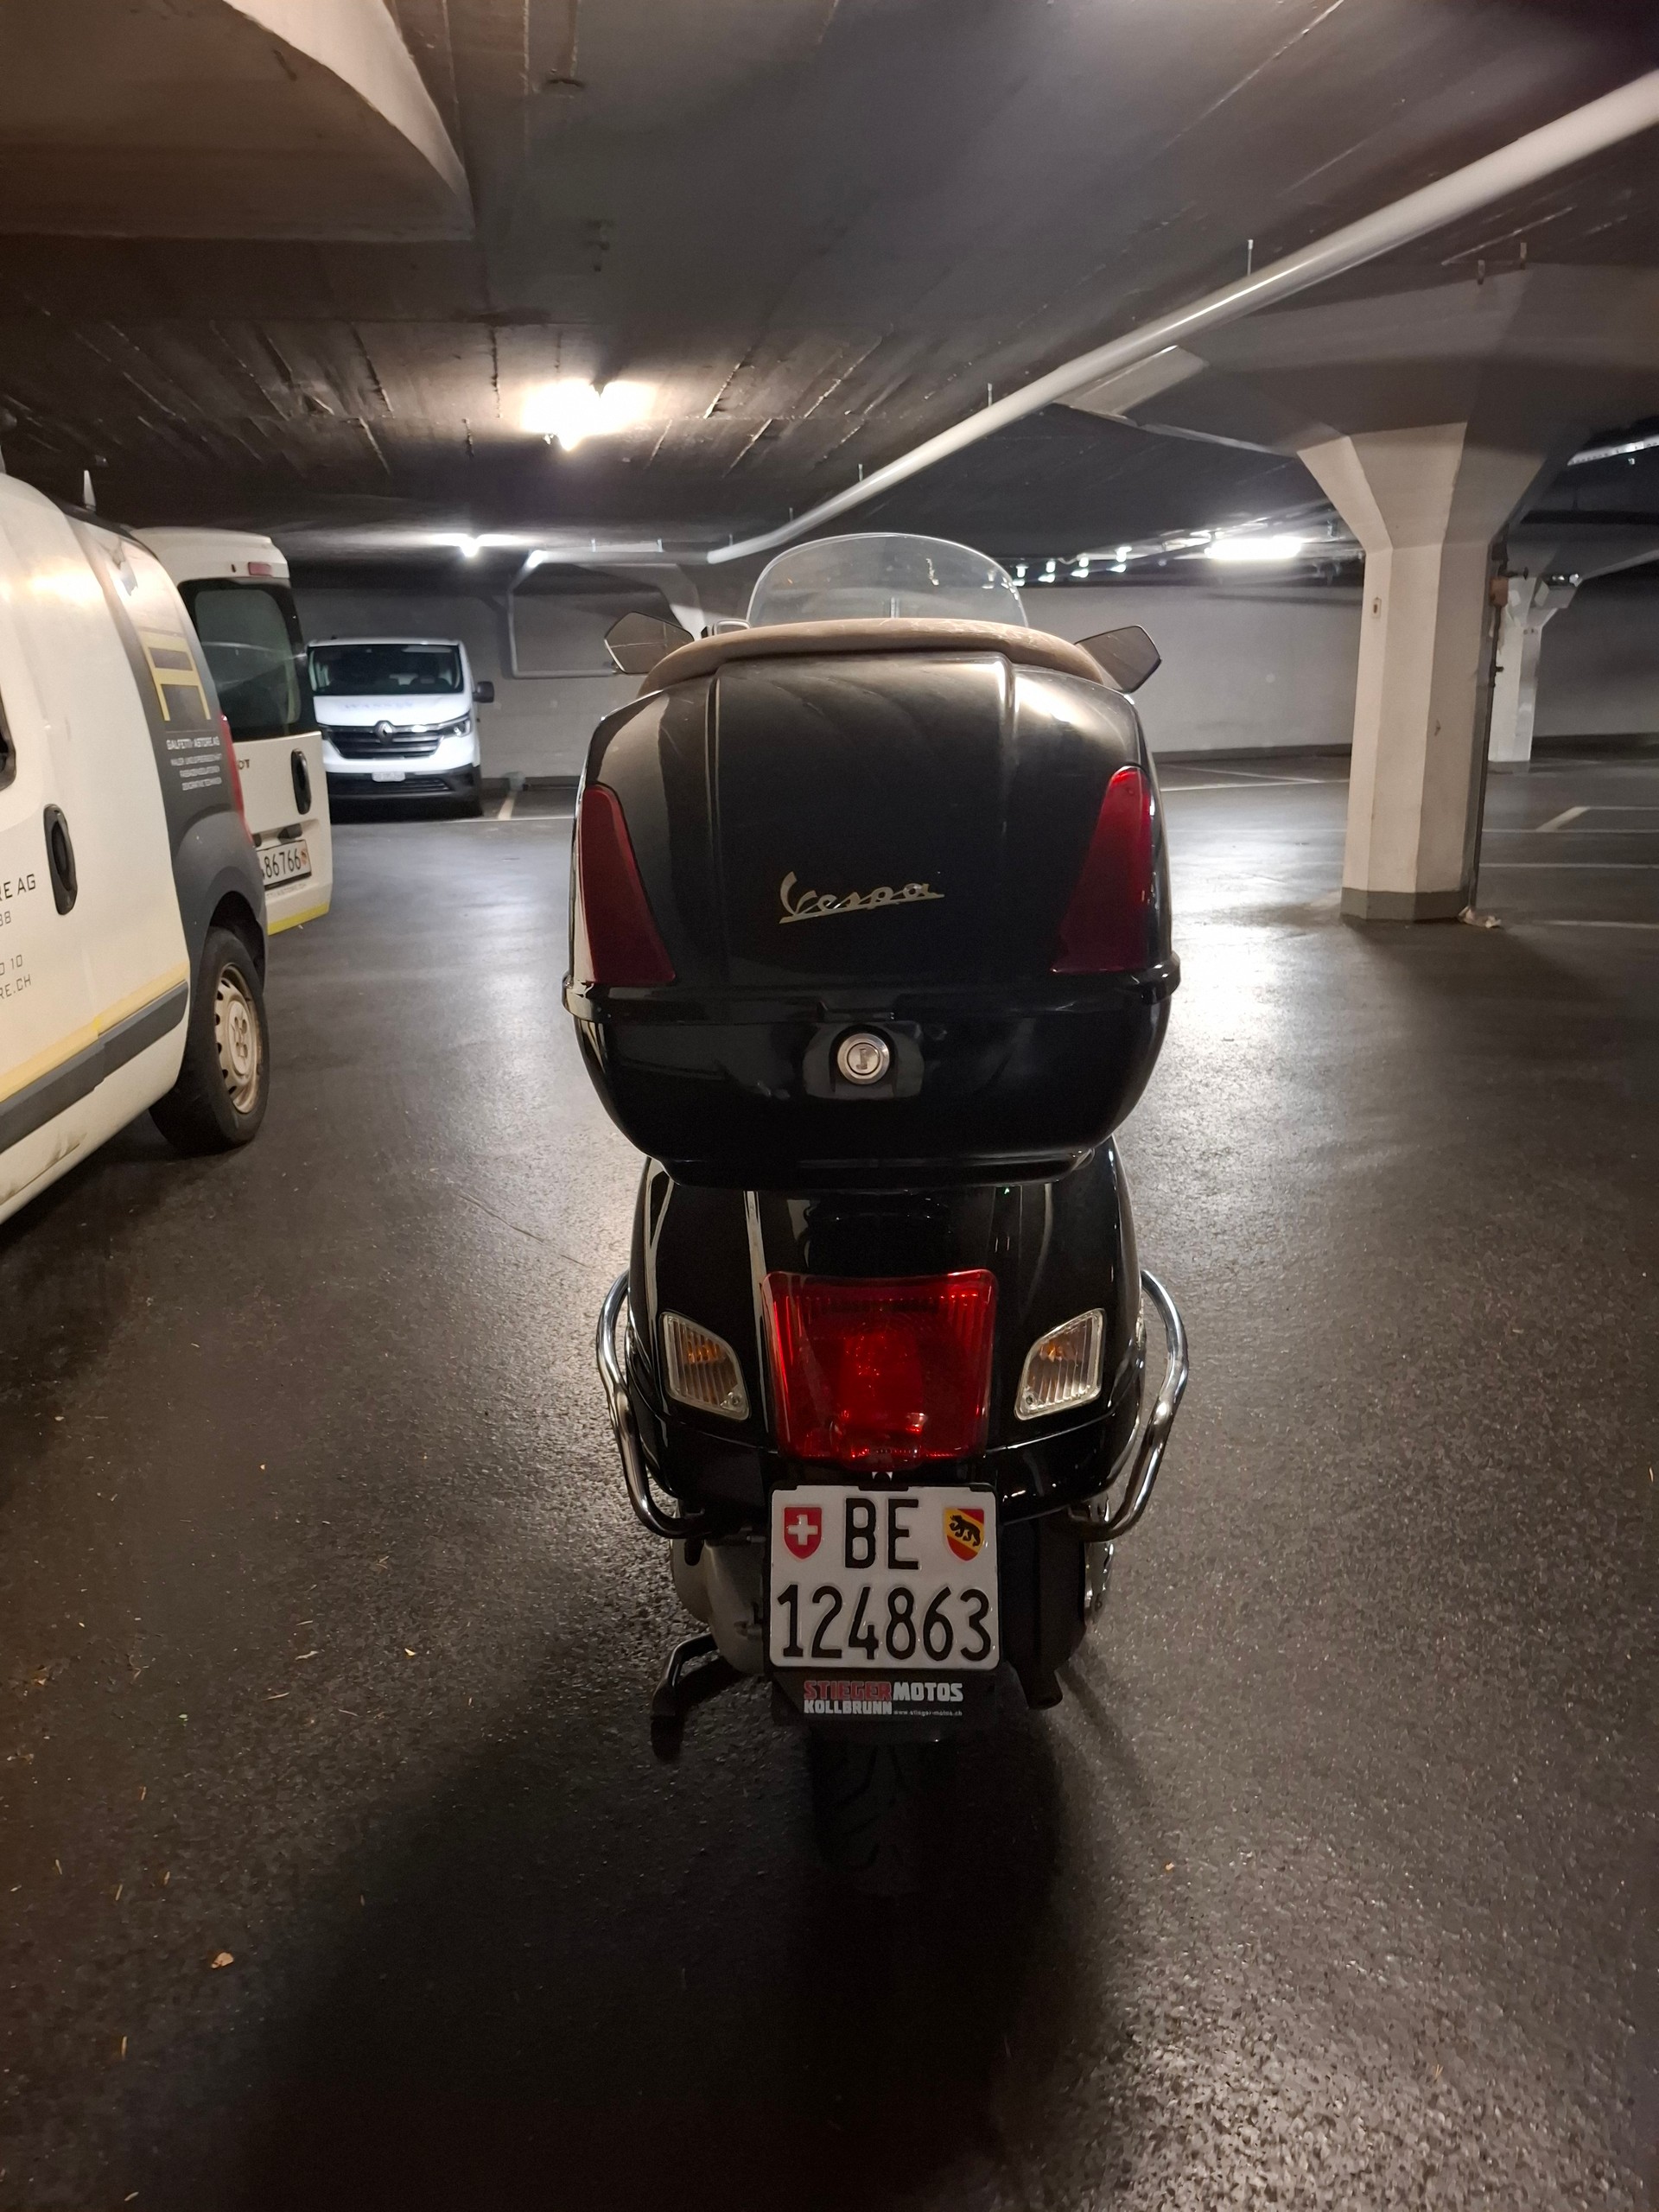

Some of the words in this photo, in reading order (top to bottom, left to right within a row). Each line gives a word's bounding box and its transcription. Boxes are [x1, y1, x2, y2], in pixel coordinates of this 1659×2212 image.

[17, 874, 35, 895] AG
[779, 871, 944, 924] Vespa
[10, 954, 22, 969] 10
[845, 1497, 919, 1570] BE
[777, 1584, 991, 1662] 124863
[804, 1700, 893, 1714] KOLLBRUNN
